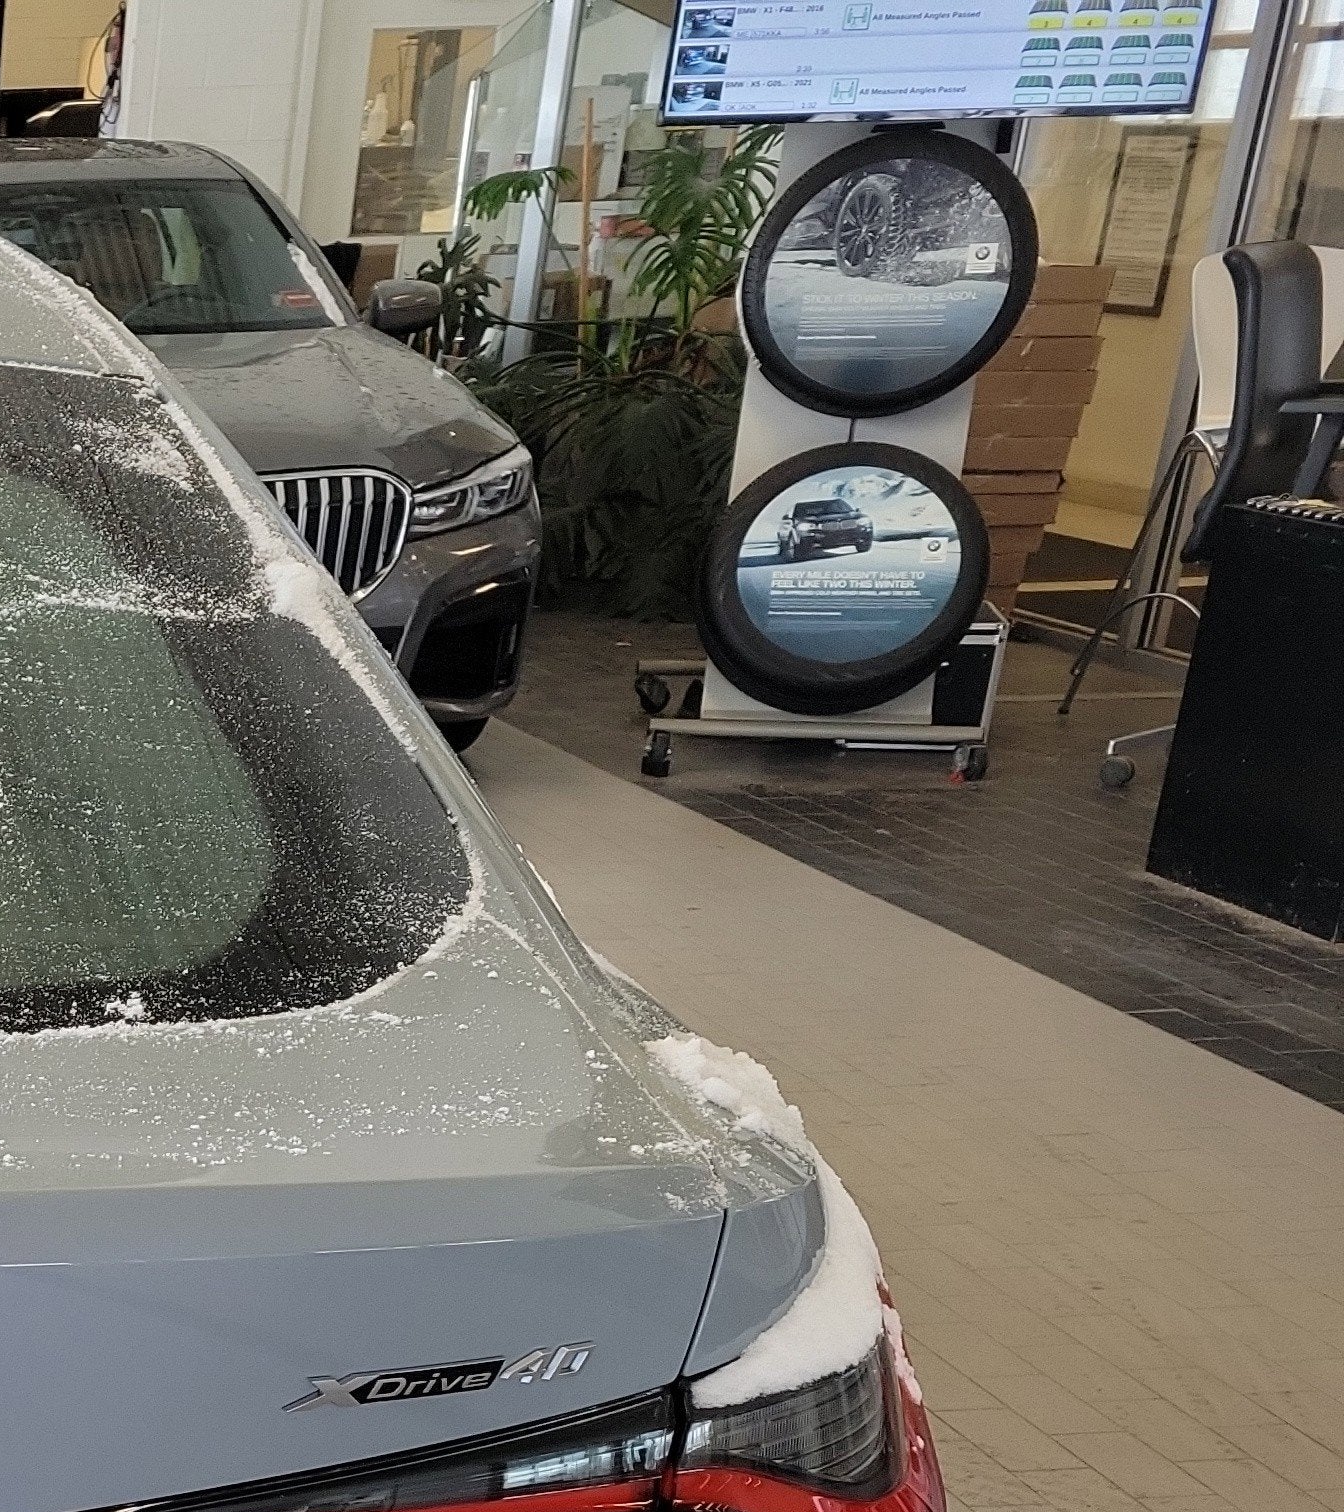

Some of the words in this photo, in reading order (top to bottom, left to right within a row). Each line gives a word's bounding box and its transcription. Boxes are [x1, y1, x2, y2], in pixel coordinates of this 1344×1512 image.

[885, 12, 922, 21] Measured
[924, 11, 950, 20] Angles
[871, 87, 908, 95] Measured
[909, 86, 937, 95] Angles
[937, 85, 966, 93] Passed
[849, 294, 862, 303] TO
[908, 292, 929, 302] THIS
[772, 571, 806, 579] EVERY
[807, 571, 832, 579] MILE
[833, 571, 878, 579] DOESN'T
[880, 571, 910, 579] HAVE
[911, 571, 925, 580] TO
[771, 580, 796, 588] FEEL
[798, 580, 821, 588] LIKE
[823, 580, 847, 589] TWO
[849, 580, 873, 588] THIS
[875, 580, 917, 588] WINTER.
